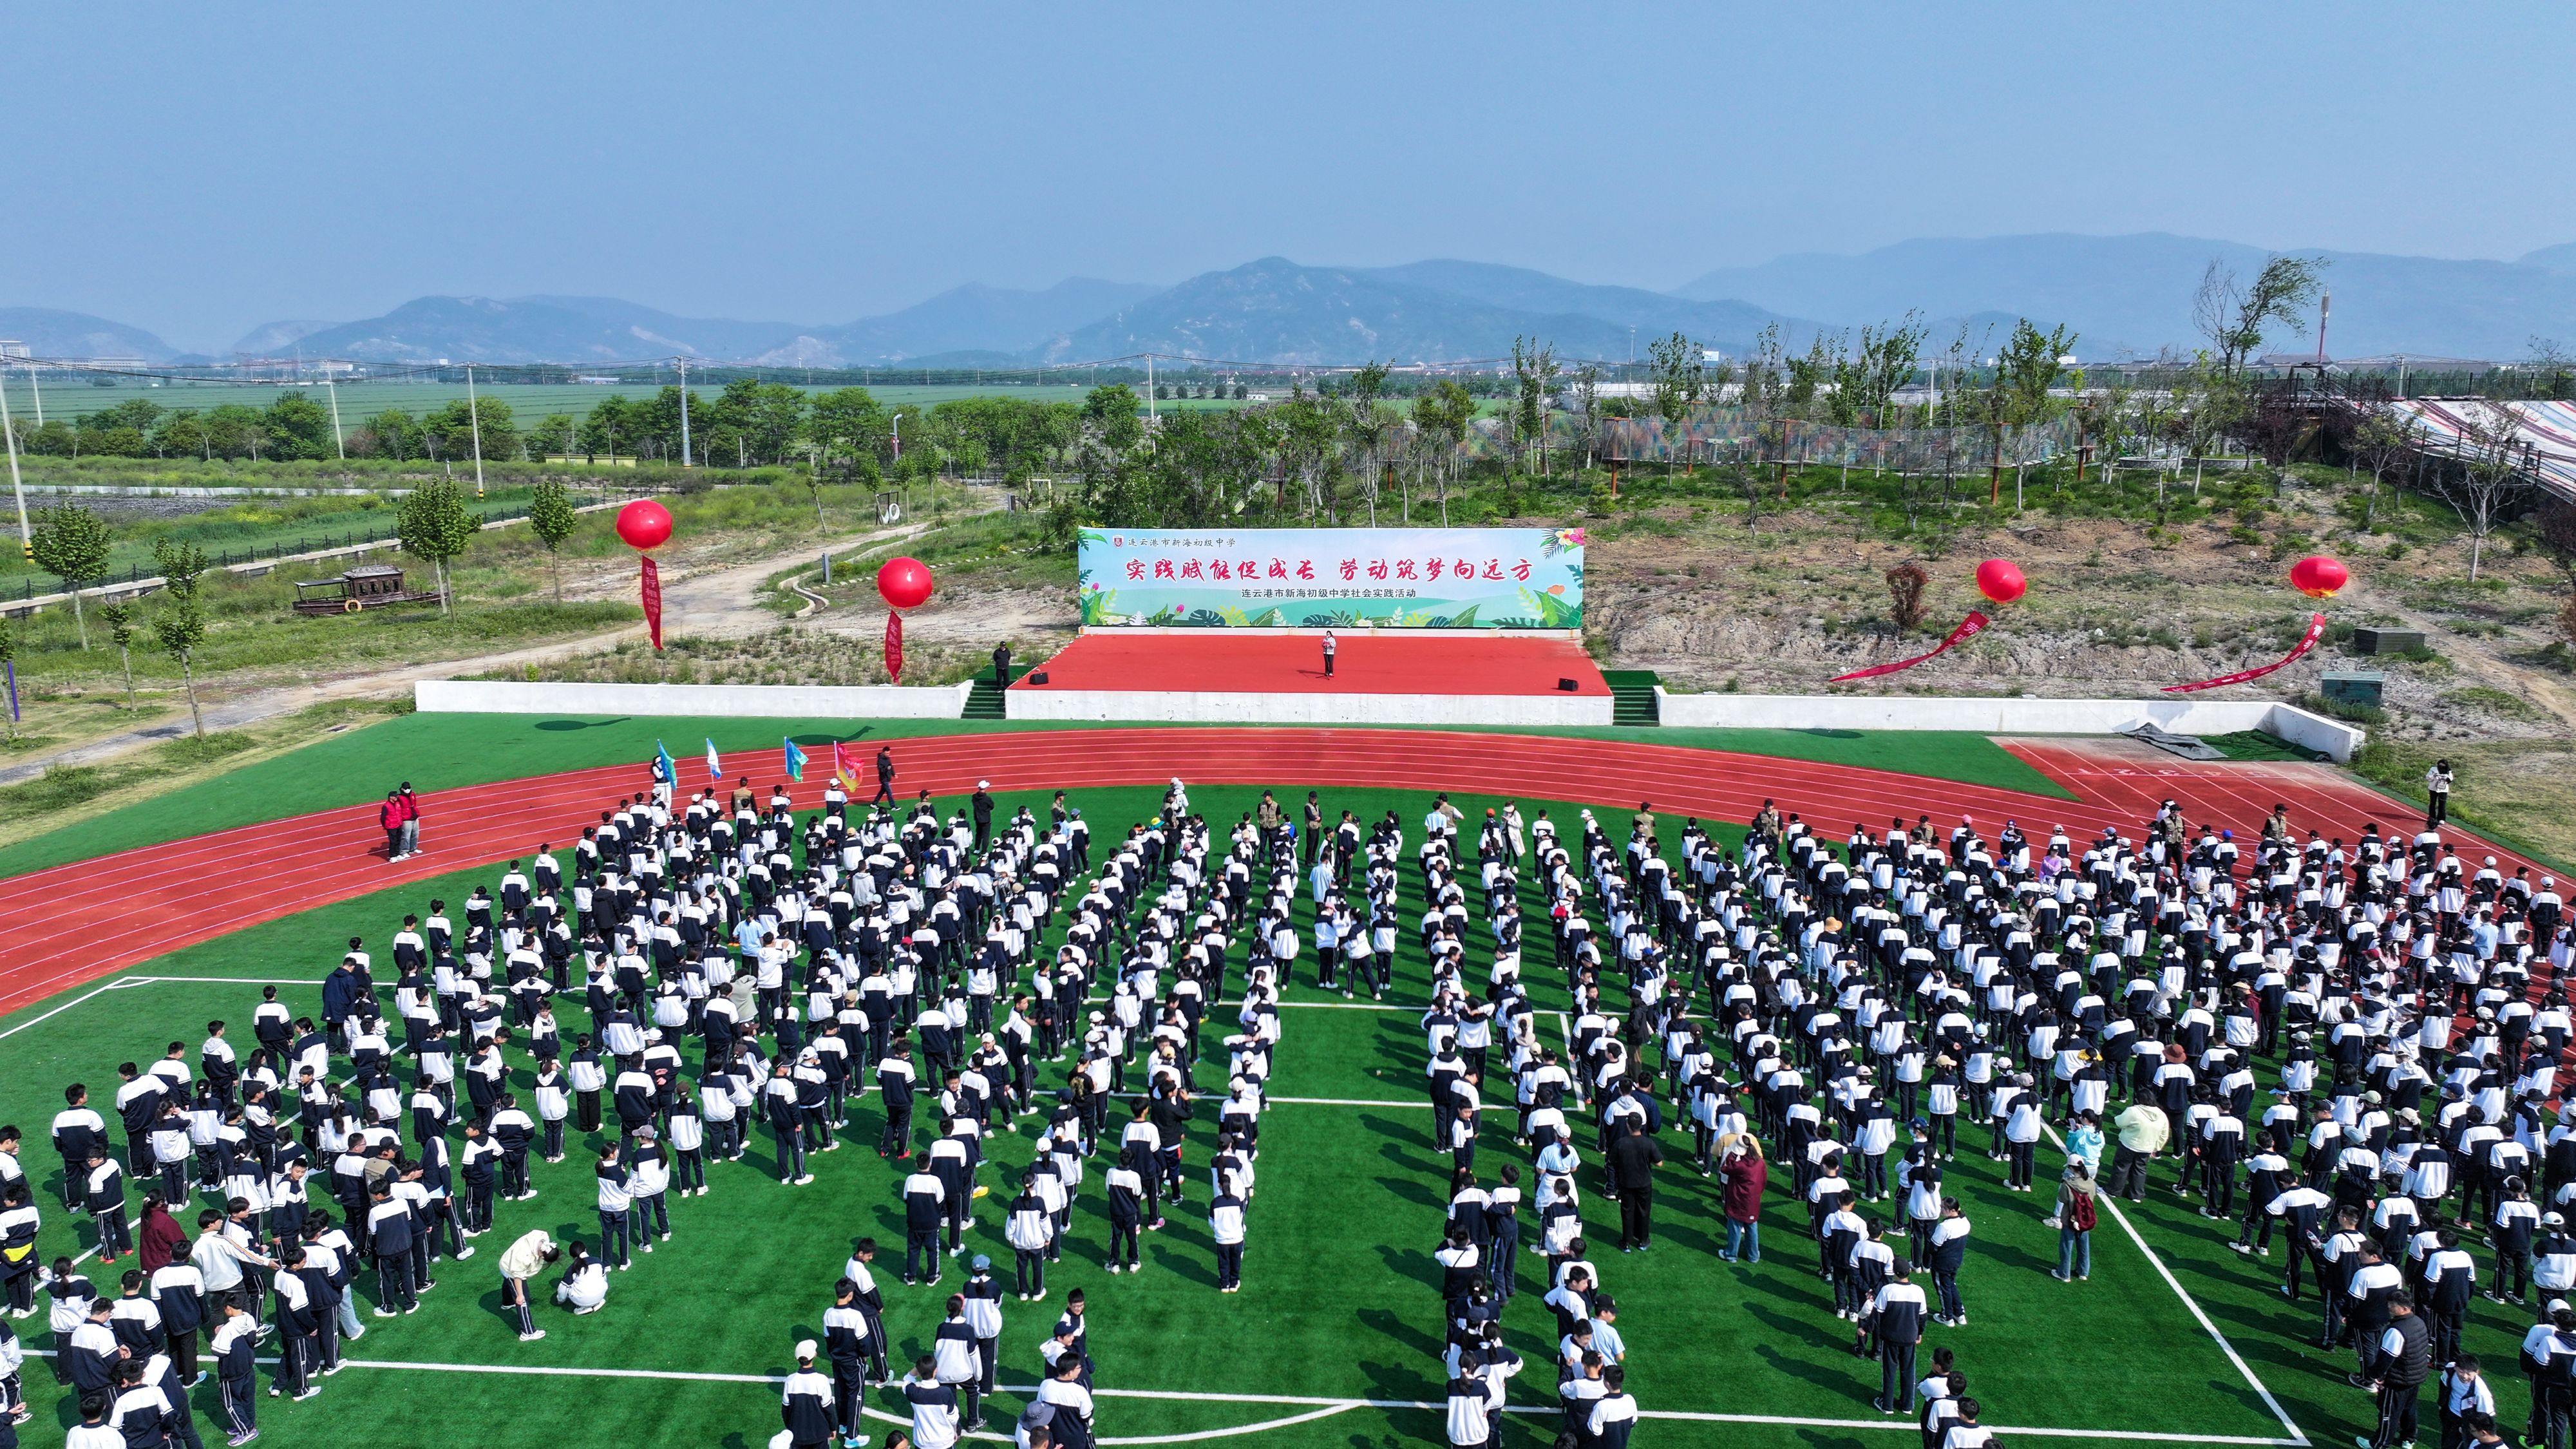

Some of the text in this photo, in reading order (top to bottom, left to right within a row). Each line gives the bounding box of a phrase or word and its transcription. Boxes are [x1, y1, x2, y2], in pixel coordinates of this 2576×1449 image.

[1128, 537, 1236, 548] 连云港市新海初级中学
[1125, 557, 1533, 582] 实践赋能促成长 劳动筑梦向远方
[1241, 588, 1416, 598] 连云港市新海初级中学社会实践活动
